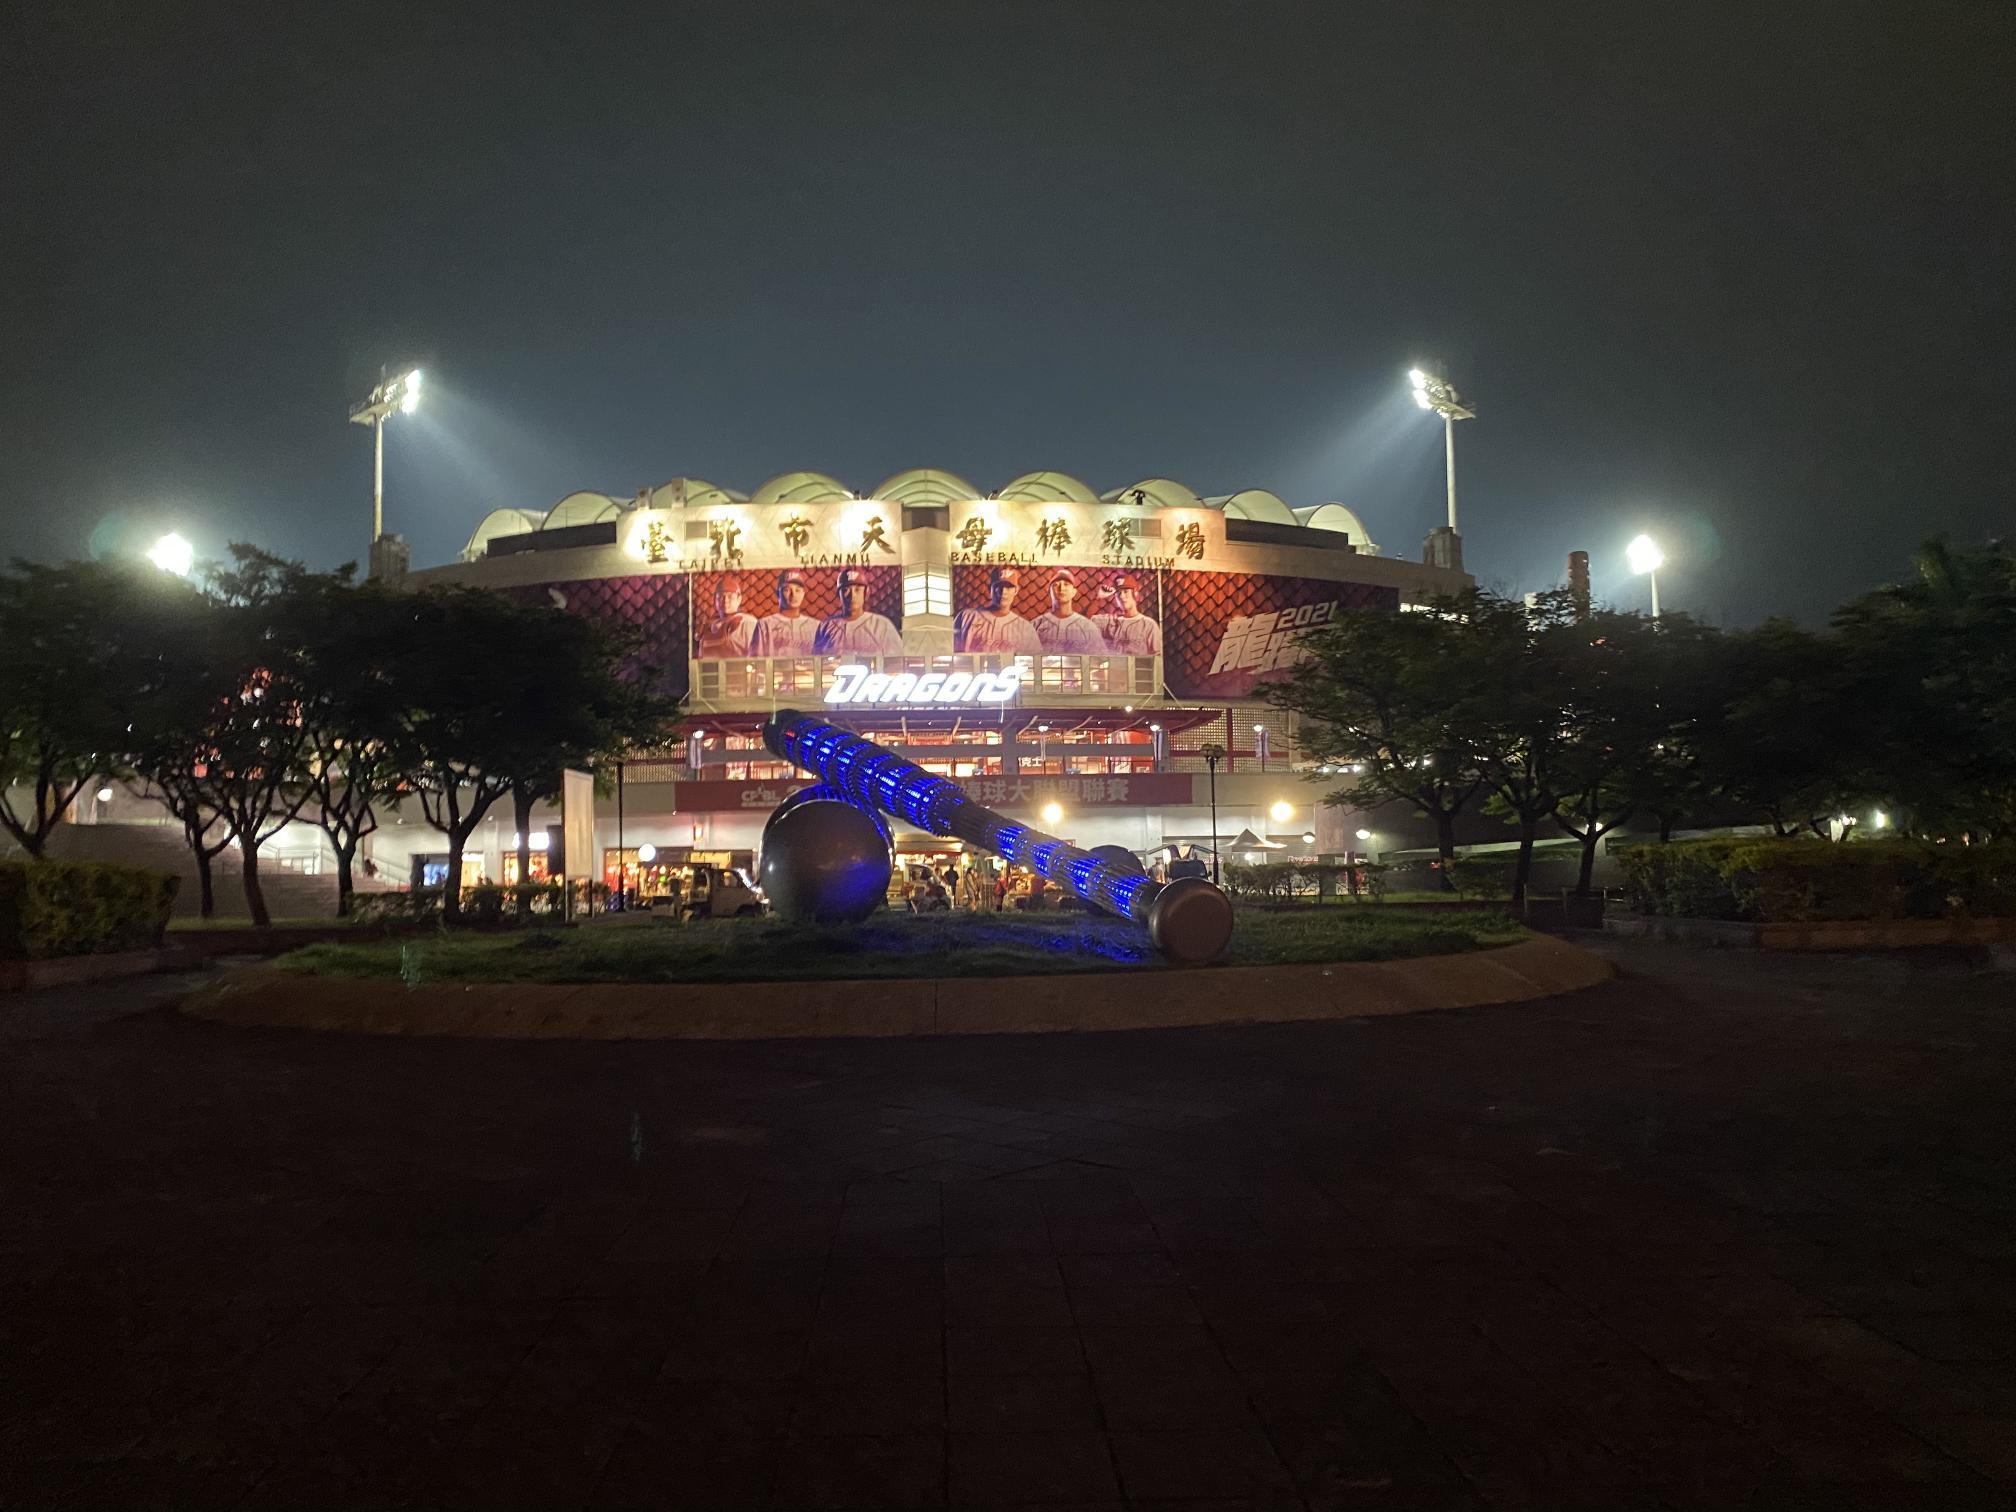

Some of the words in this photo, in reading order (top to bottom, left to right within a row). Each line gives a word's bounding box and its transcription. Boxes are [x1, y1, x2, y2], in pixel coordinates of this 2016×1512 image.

[950, 551, 1038, 564] BASEBALL
[1102, 554, 1175, 569] STADIUM
[1276, 601, 1338, 629] 2021
[824, 665, 1028, 703] DRAGONS
